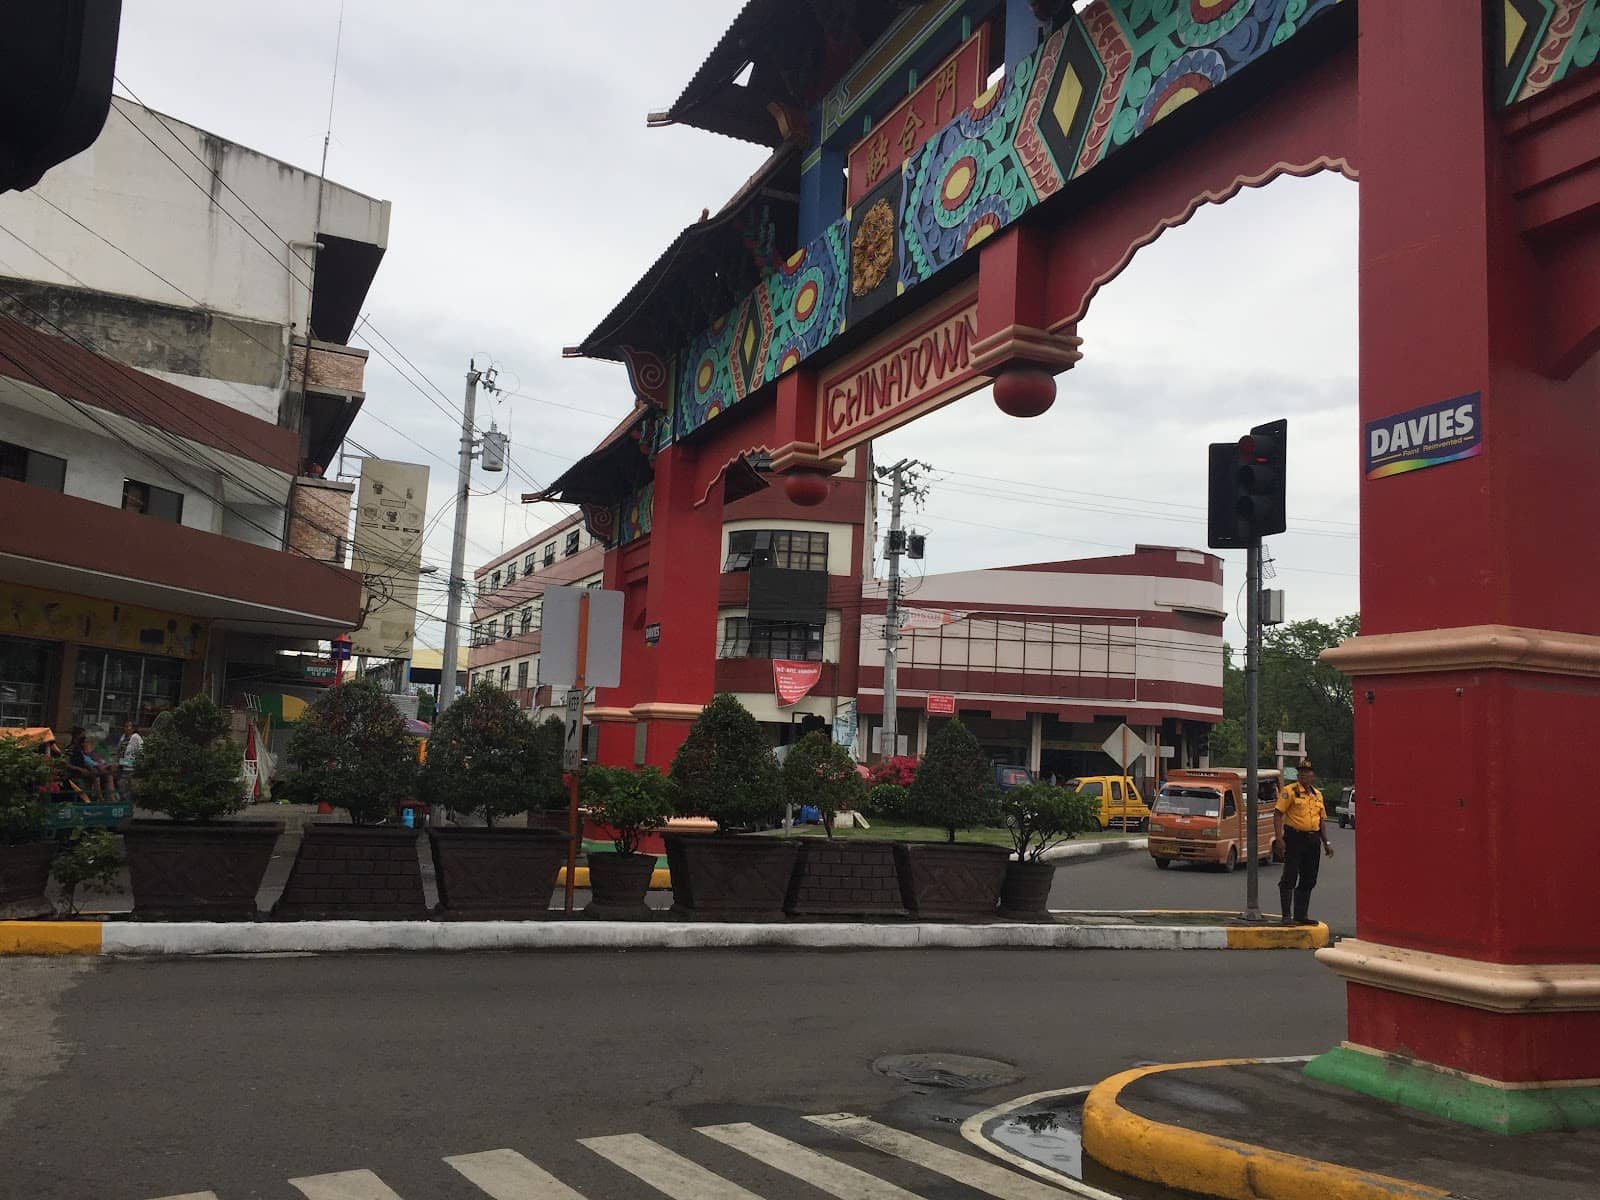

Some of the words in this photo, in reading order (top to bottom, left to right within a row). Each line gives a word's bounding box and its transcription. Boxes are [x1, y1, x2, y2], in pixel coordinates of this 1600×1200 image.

[828, 314, 978, 434] CHINATOWN
[1371, 404, 1474, 457] DAVIES
[1423, 437, 1463, 452] Reinvented
